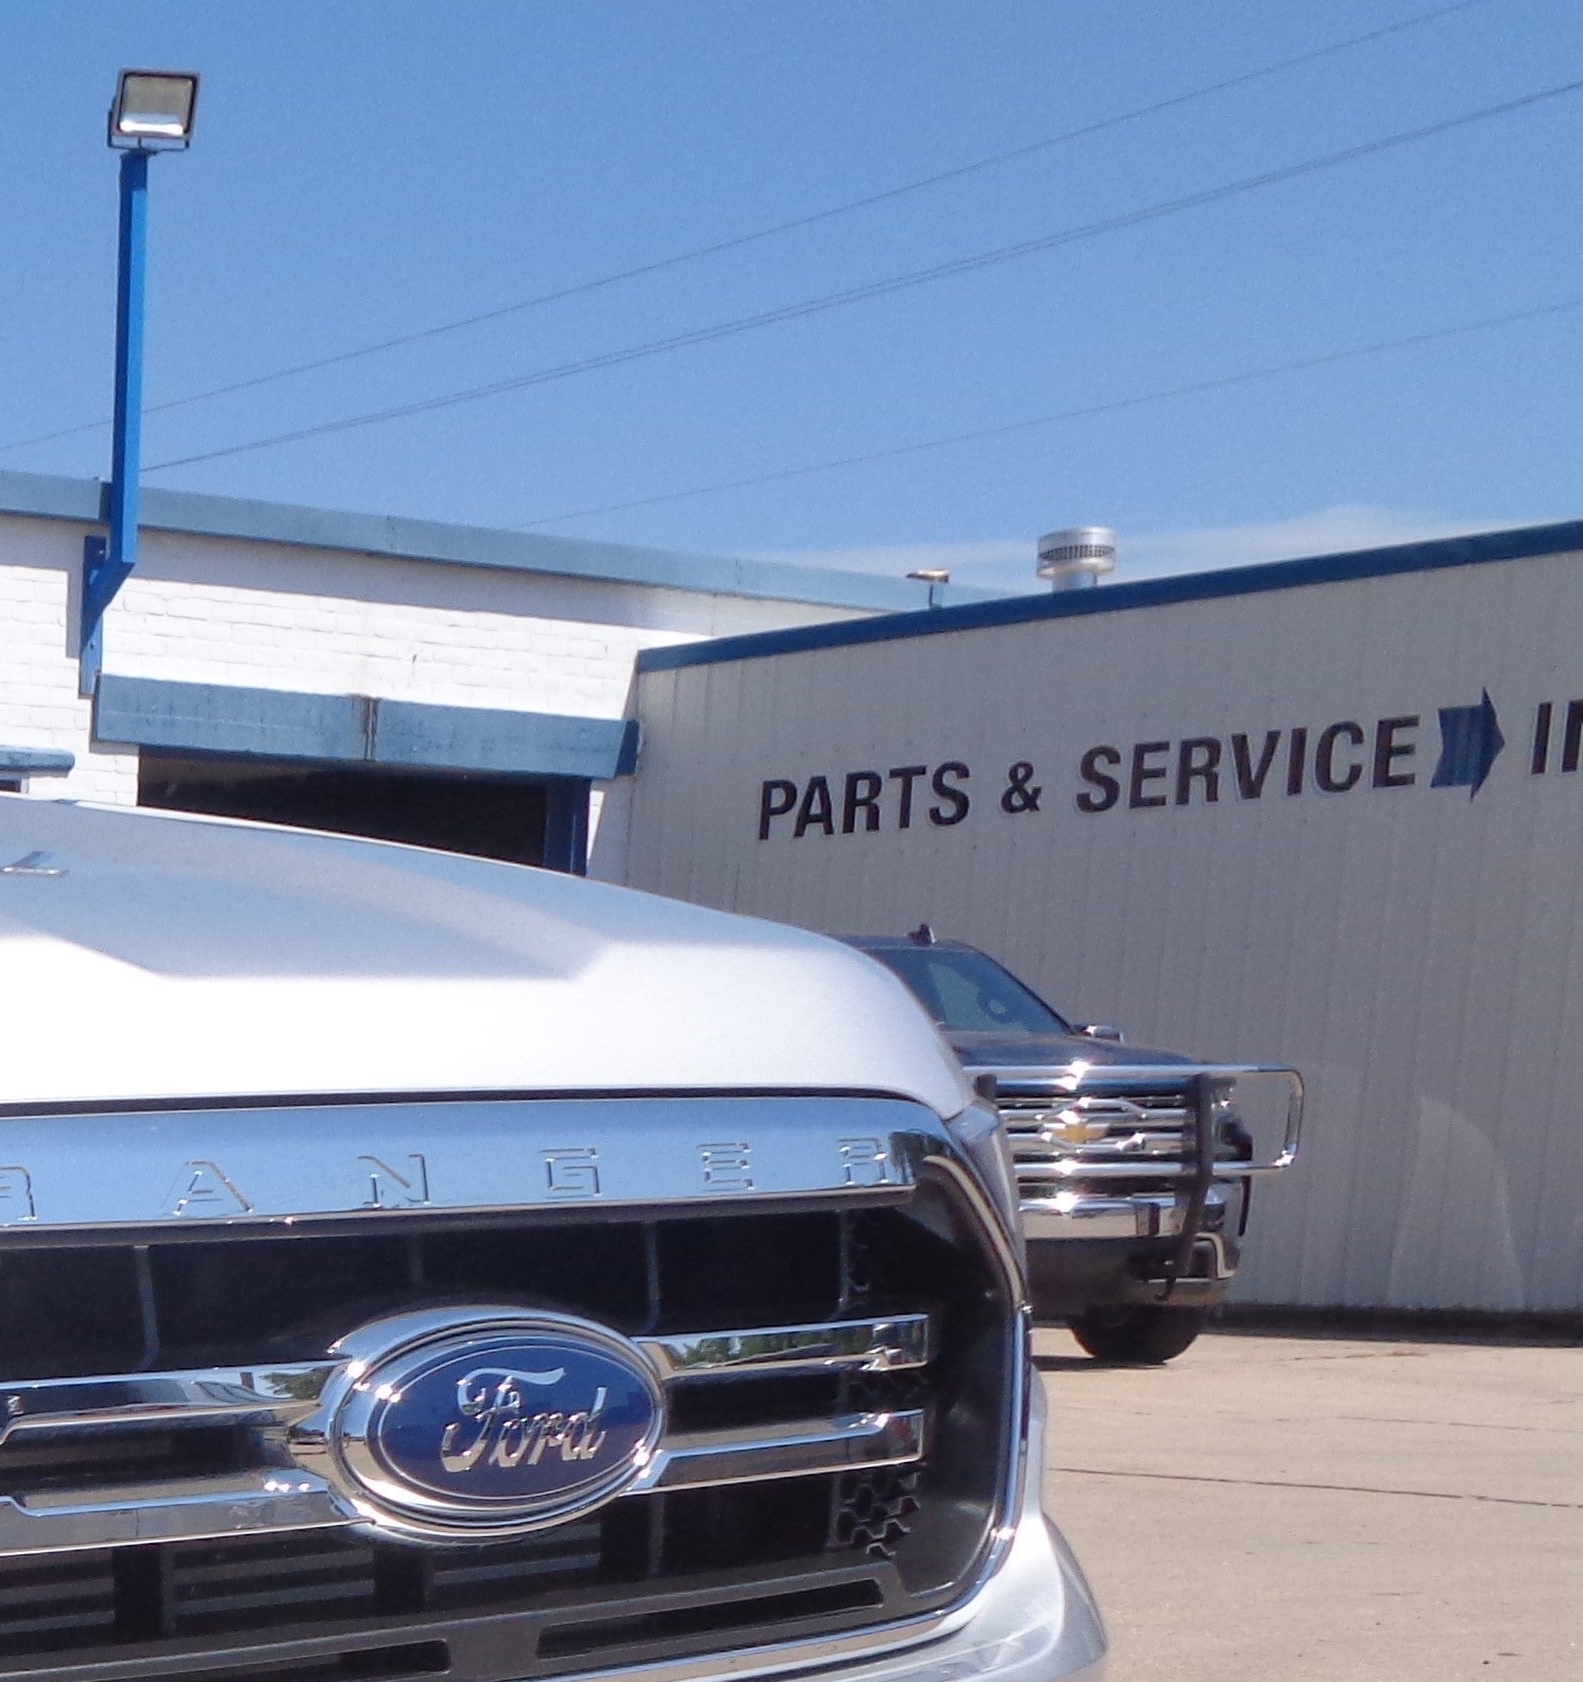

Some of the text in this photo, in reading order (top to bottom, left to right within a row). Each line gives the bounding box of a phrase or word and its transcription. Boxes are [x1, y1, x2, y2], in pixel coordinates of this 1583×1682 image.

[758, 760, 971, 841] PARTS
[999, 760, 1043, 815] &
[1076, 713, 1422, 813] SERVICE
[439, 1366, 609, 1474] Ford
